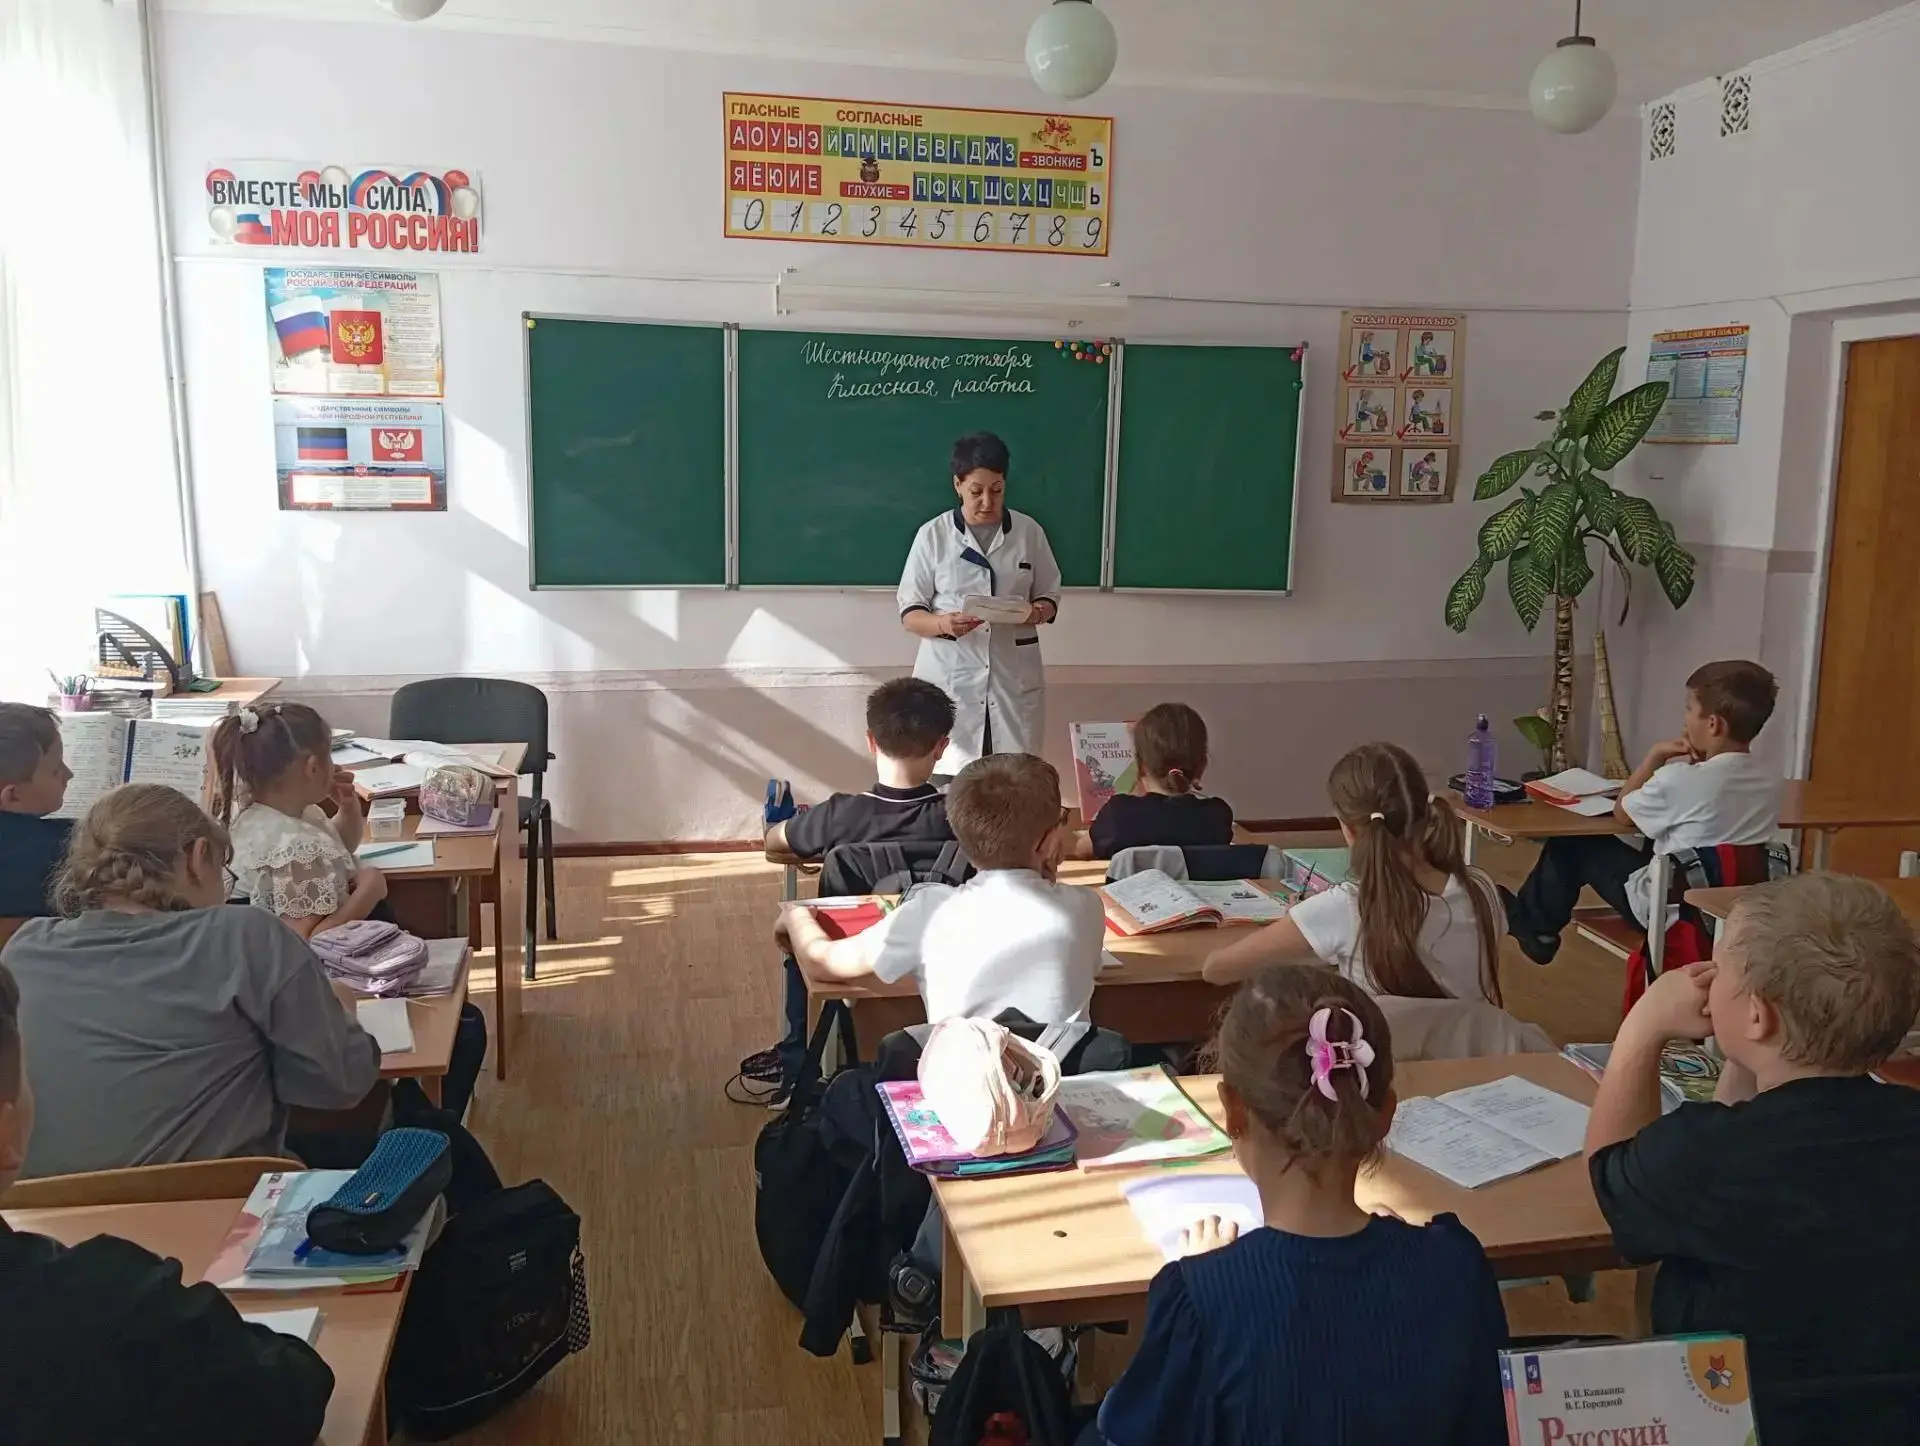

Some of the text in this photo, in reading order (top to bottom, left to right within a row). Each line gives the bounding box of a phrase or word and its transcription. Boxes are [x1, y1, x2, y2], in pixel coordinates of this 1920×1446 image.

[731, 102, 800, 119] ГЛАСНЫЕ
[836, 109, 922, 127] СОГЛАСНЫЕ
[1031, 155, 1082, 169] ЗВОНКИЕ
[212, 180, 433, 214] ВМЕСТЕ МЫ СИЛА,
[847, 184, 893, 198] ГЛУХИЕ
[271, 209, 479, 253] МОЯ РОССИЯ!
[744, 198, 1102, 248] 0 1 2 3 4 5 6 7 8 9
[286, 270, 417, 281] ГОСУДАРСТВЕННЫЕ СИМВОЛЫ
[287, 279, 418, 290] РОССИЙСКОЙ ФЕДЕРАЦИИ
[1353, 315, 1456, 327] СИДИ ПРАВИЛЬНО
[800, 340, 1033, 378] Шестнадцатое октября
[951, 374, 1036, 398] работа
[1537, 1416, 1670, 1446] Русский
